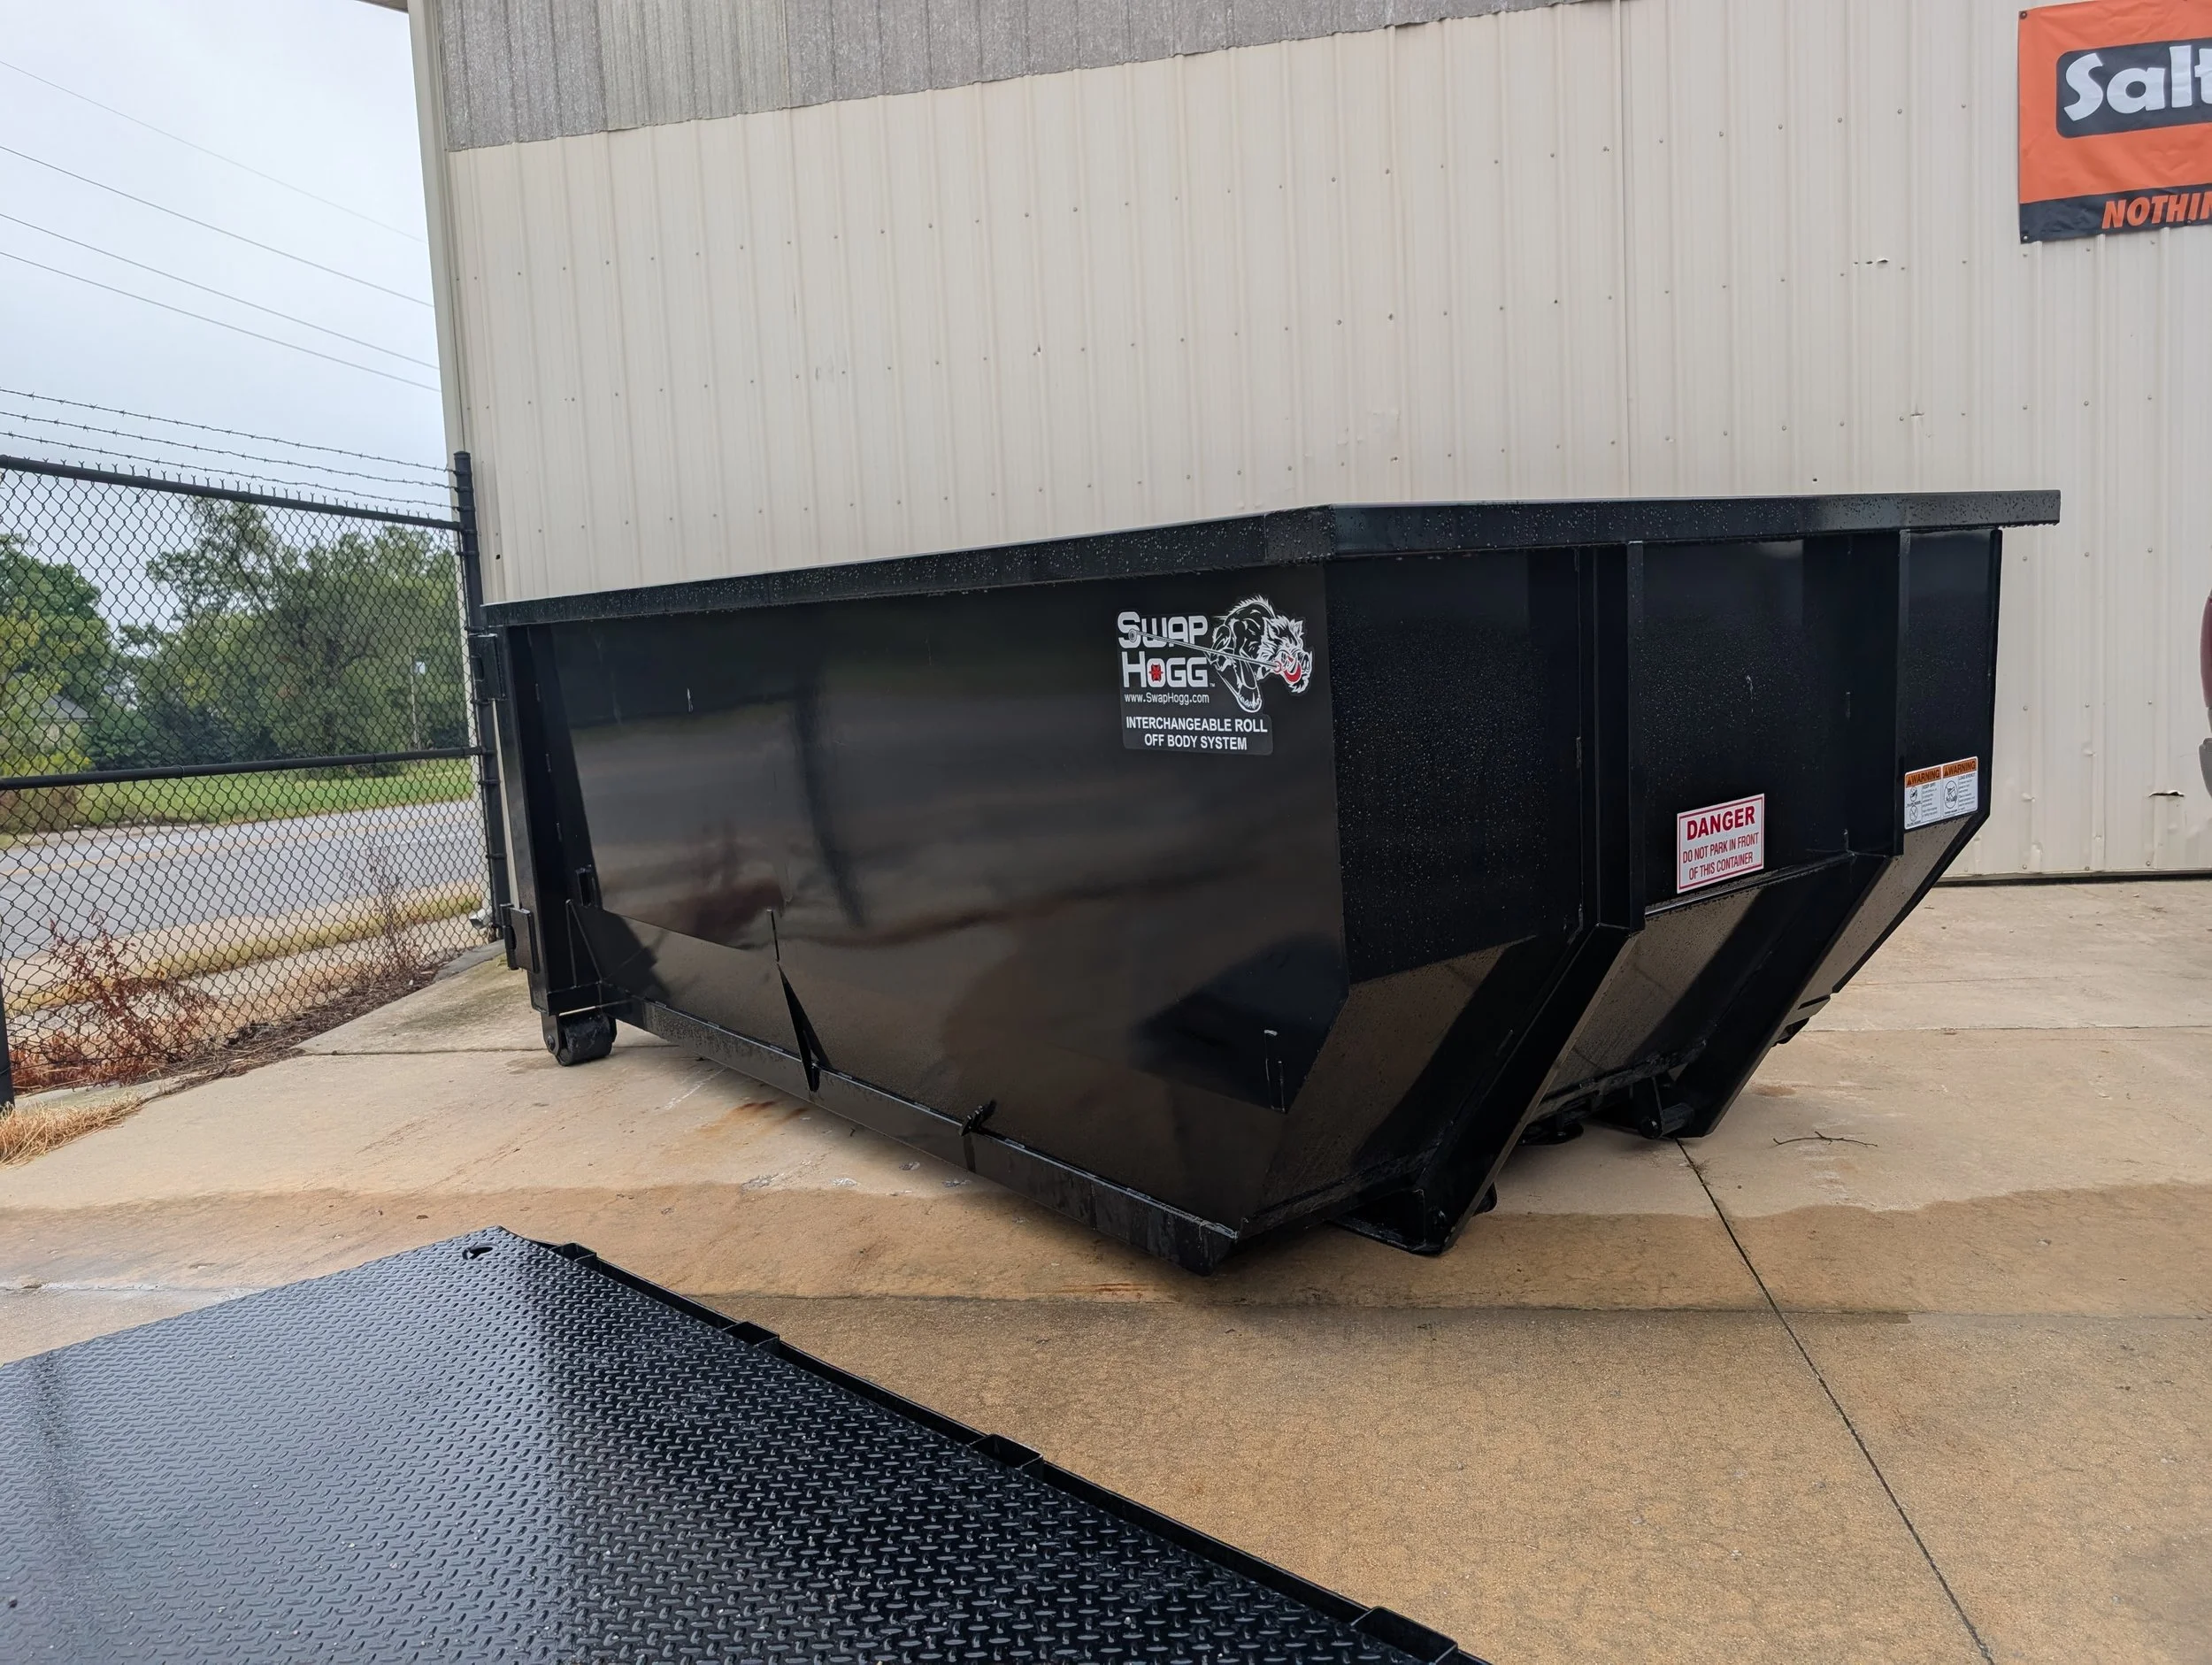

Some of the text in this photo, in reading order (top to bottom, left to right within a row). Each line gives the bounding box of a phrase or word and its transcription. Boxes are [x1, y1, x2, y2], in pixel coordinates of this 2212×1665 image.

[1121, 650, 1209, 687] HOGG
[1124, 692, 1210, 706] www.SwapHogg.com
[1125, 716, 1268, 733] INTERCHANGEABLE ROLL
[1144, 733, 1248, 751] OFF BODY SYSTEM
[1912, 769, 1940, 784] WARNING
[1948, 761, 1976, 775] WARNING
[1686, 805, 1755, 840] DANGER
[1683, 832, 1759, 863] DO NOT PARK IN FRONT
[1689, 851, 1754, 880] OF THIS CONTAINER
